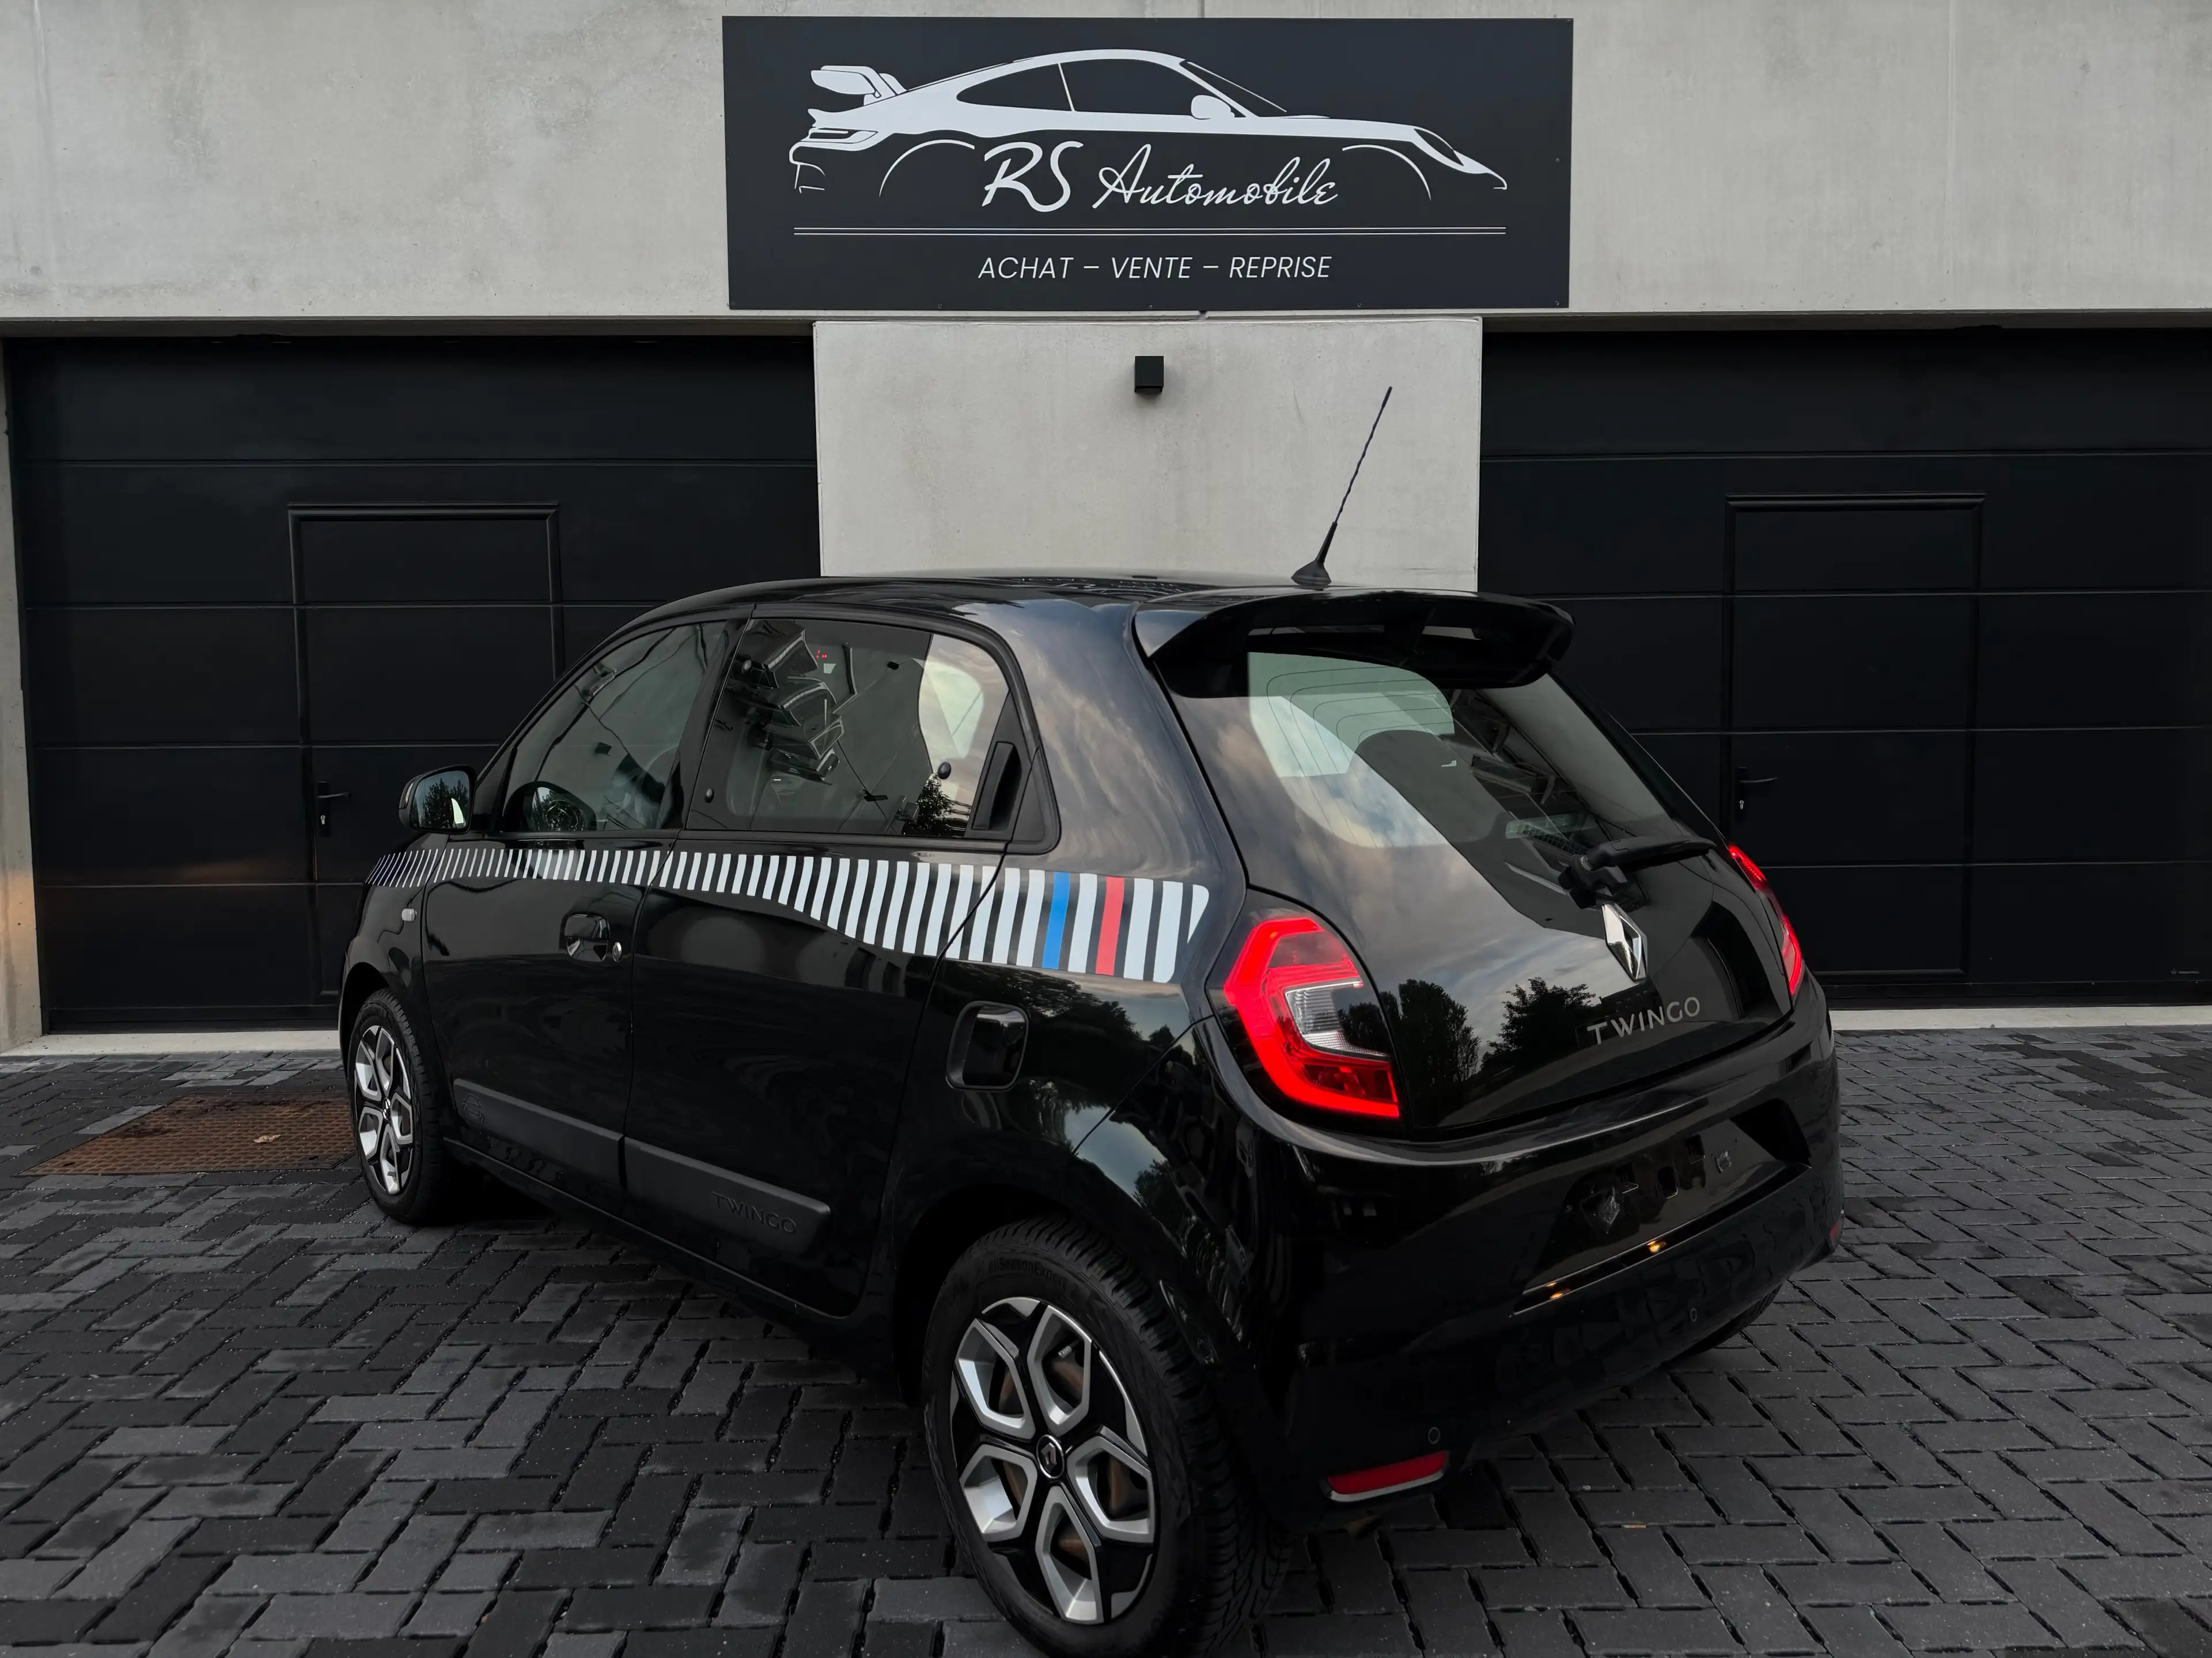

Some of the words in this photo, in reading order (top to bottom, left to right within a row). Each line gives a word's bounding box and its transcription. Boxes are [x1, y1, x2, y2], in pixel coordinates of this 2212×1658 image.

[982, 141, 1084, 213] RS
[1092, 144, 1338, 209] Automobile
[978, 257, 1074, 279] ACHAT
[1111, 257, 1193, 279] VENTE
[1229, 256, 1332, 278] REPRISE
[1587, 996, 1701, 1045] TWINGO
[711, 1191, 797, 1235] TWINGO
